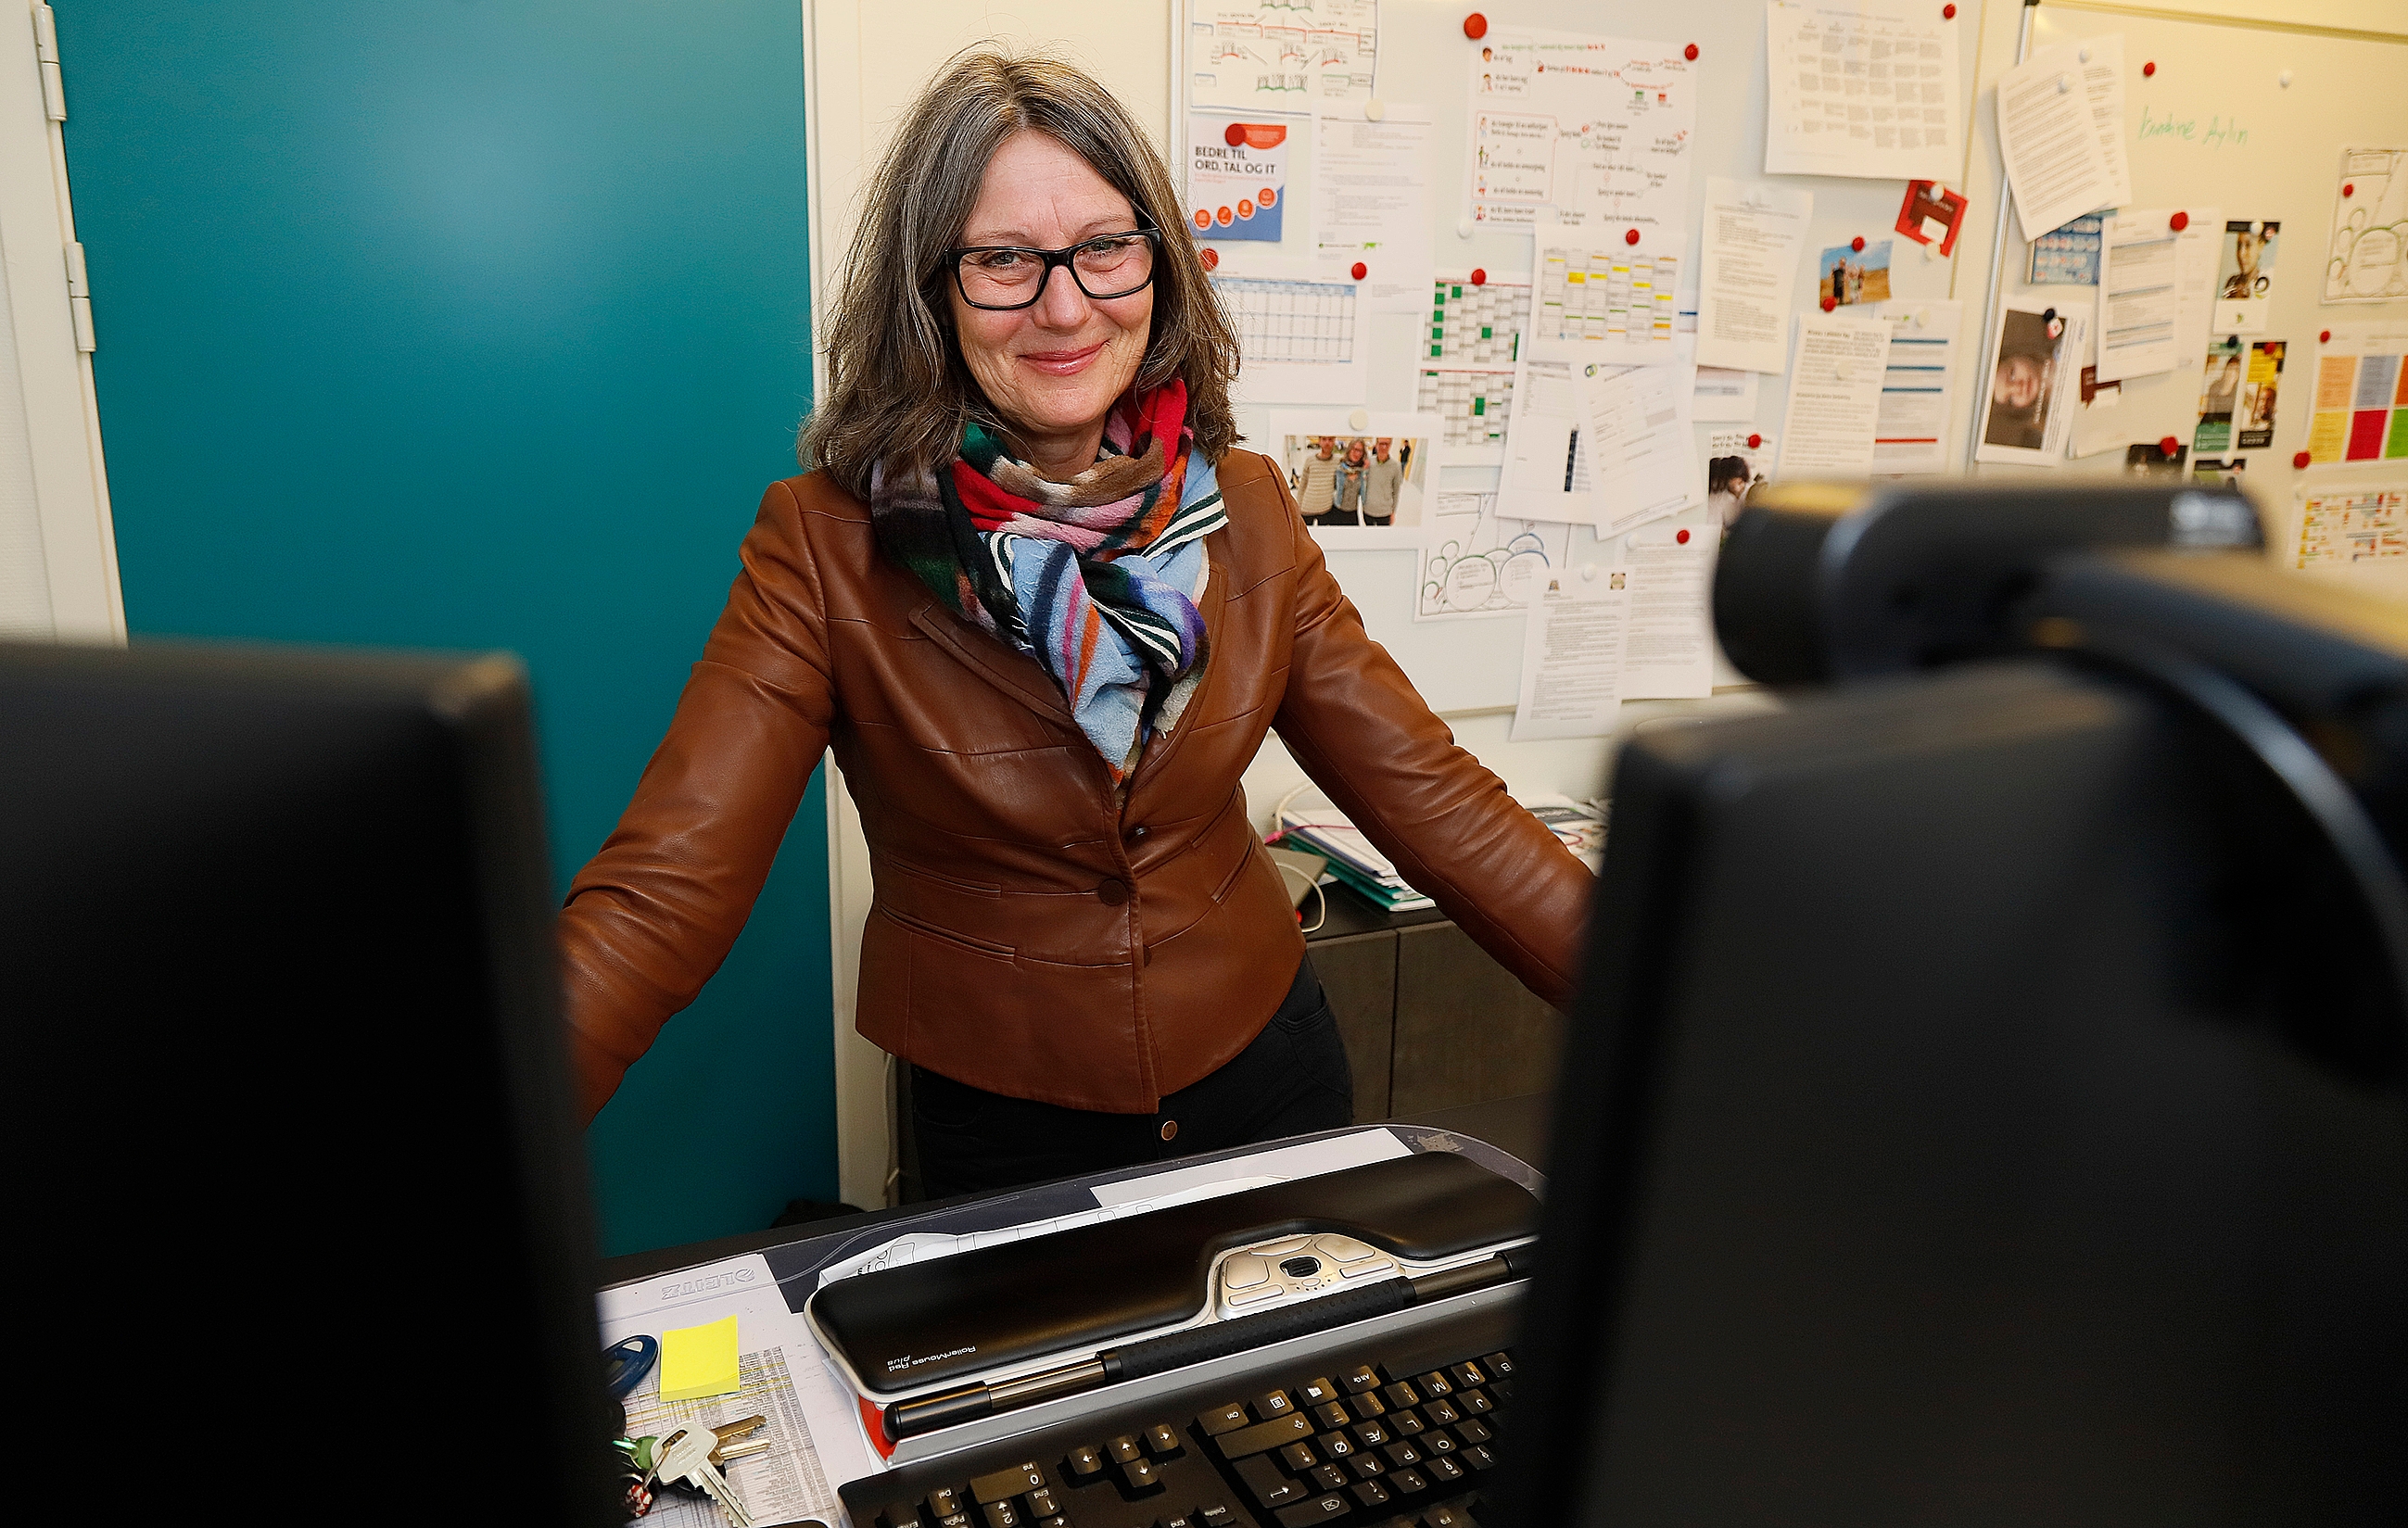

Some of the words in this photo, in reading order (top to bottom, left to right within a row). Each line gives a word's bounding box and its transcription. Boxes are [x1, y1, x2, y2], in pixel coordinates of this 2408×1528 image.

[1195, 145, 1228, 159] BEDRE
[1232, 148, 1247, 160] TIL
[1223, 161, 1242, 173] TAL
[1245, 162, 1262, 174] OG
[1265, 163, 1276, 174] IT
[661, 1271, 735, 1300] LEITZ
[887, 1355, 911, 1366] plus
[912, 1345, 977, 1366] RollerMouse
[889, 1362, 909, 1372] Red
[1466, 1371, 1480, 1383] N
[1432, 1381, 1447, 1393] M
[1226, 1411, 1239, 1421] Ctrl
[1440, 1408, 1453, 1420] K
[1365, 1429, 1382, 1443] Æ
[1334, 1440, 1348, 1454] Ø
[1404, 1449, 1415, 1460] P
[1022, 1463, 1034, 1471] Ins
[1029, 1473, 1039, 1485] 0
[938, 1488, 952, 1499] Del
[1033, 1488, 1049, 1500] End
[944, 1515, 966, 1526] PgDn
[1002, 1512, 1013, 1524] 2
